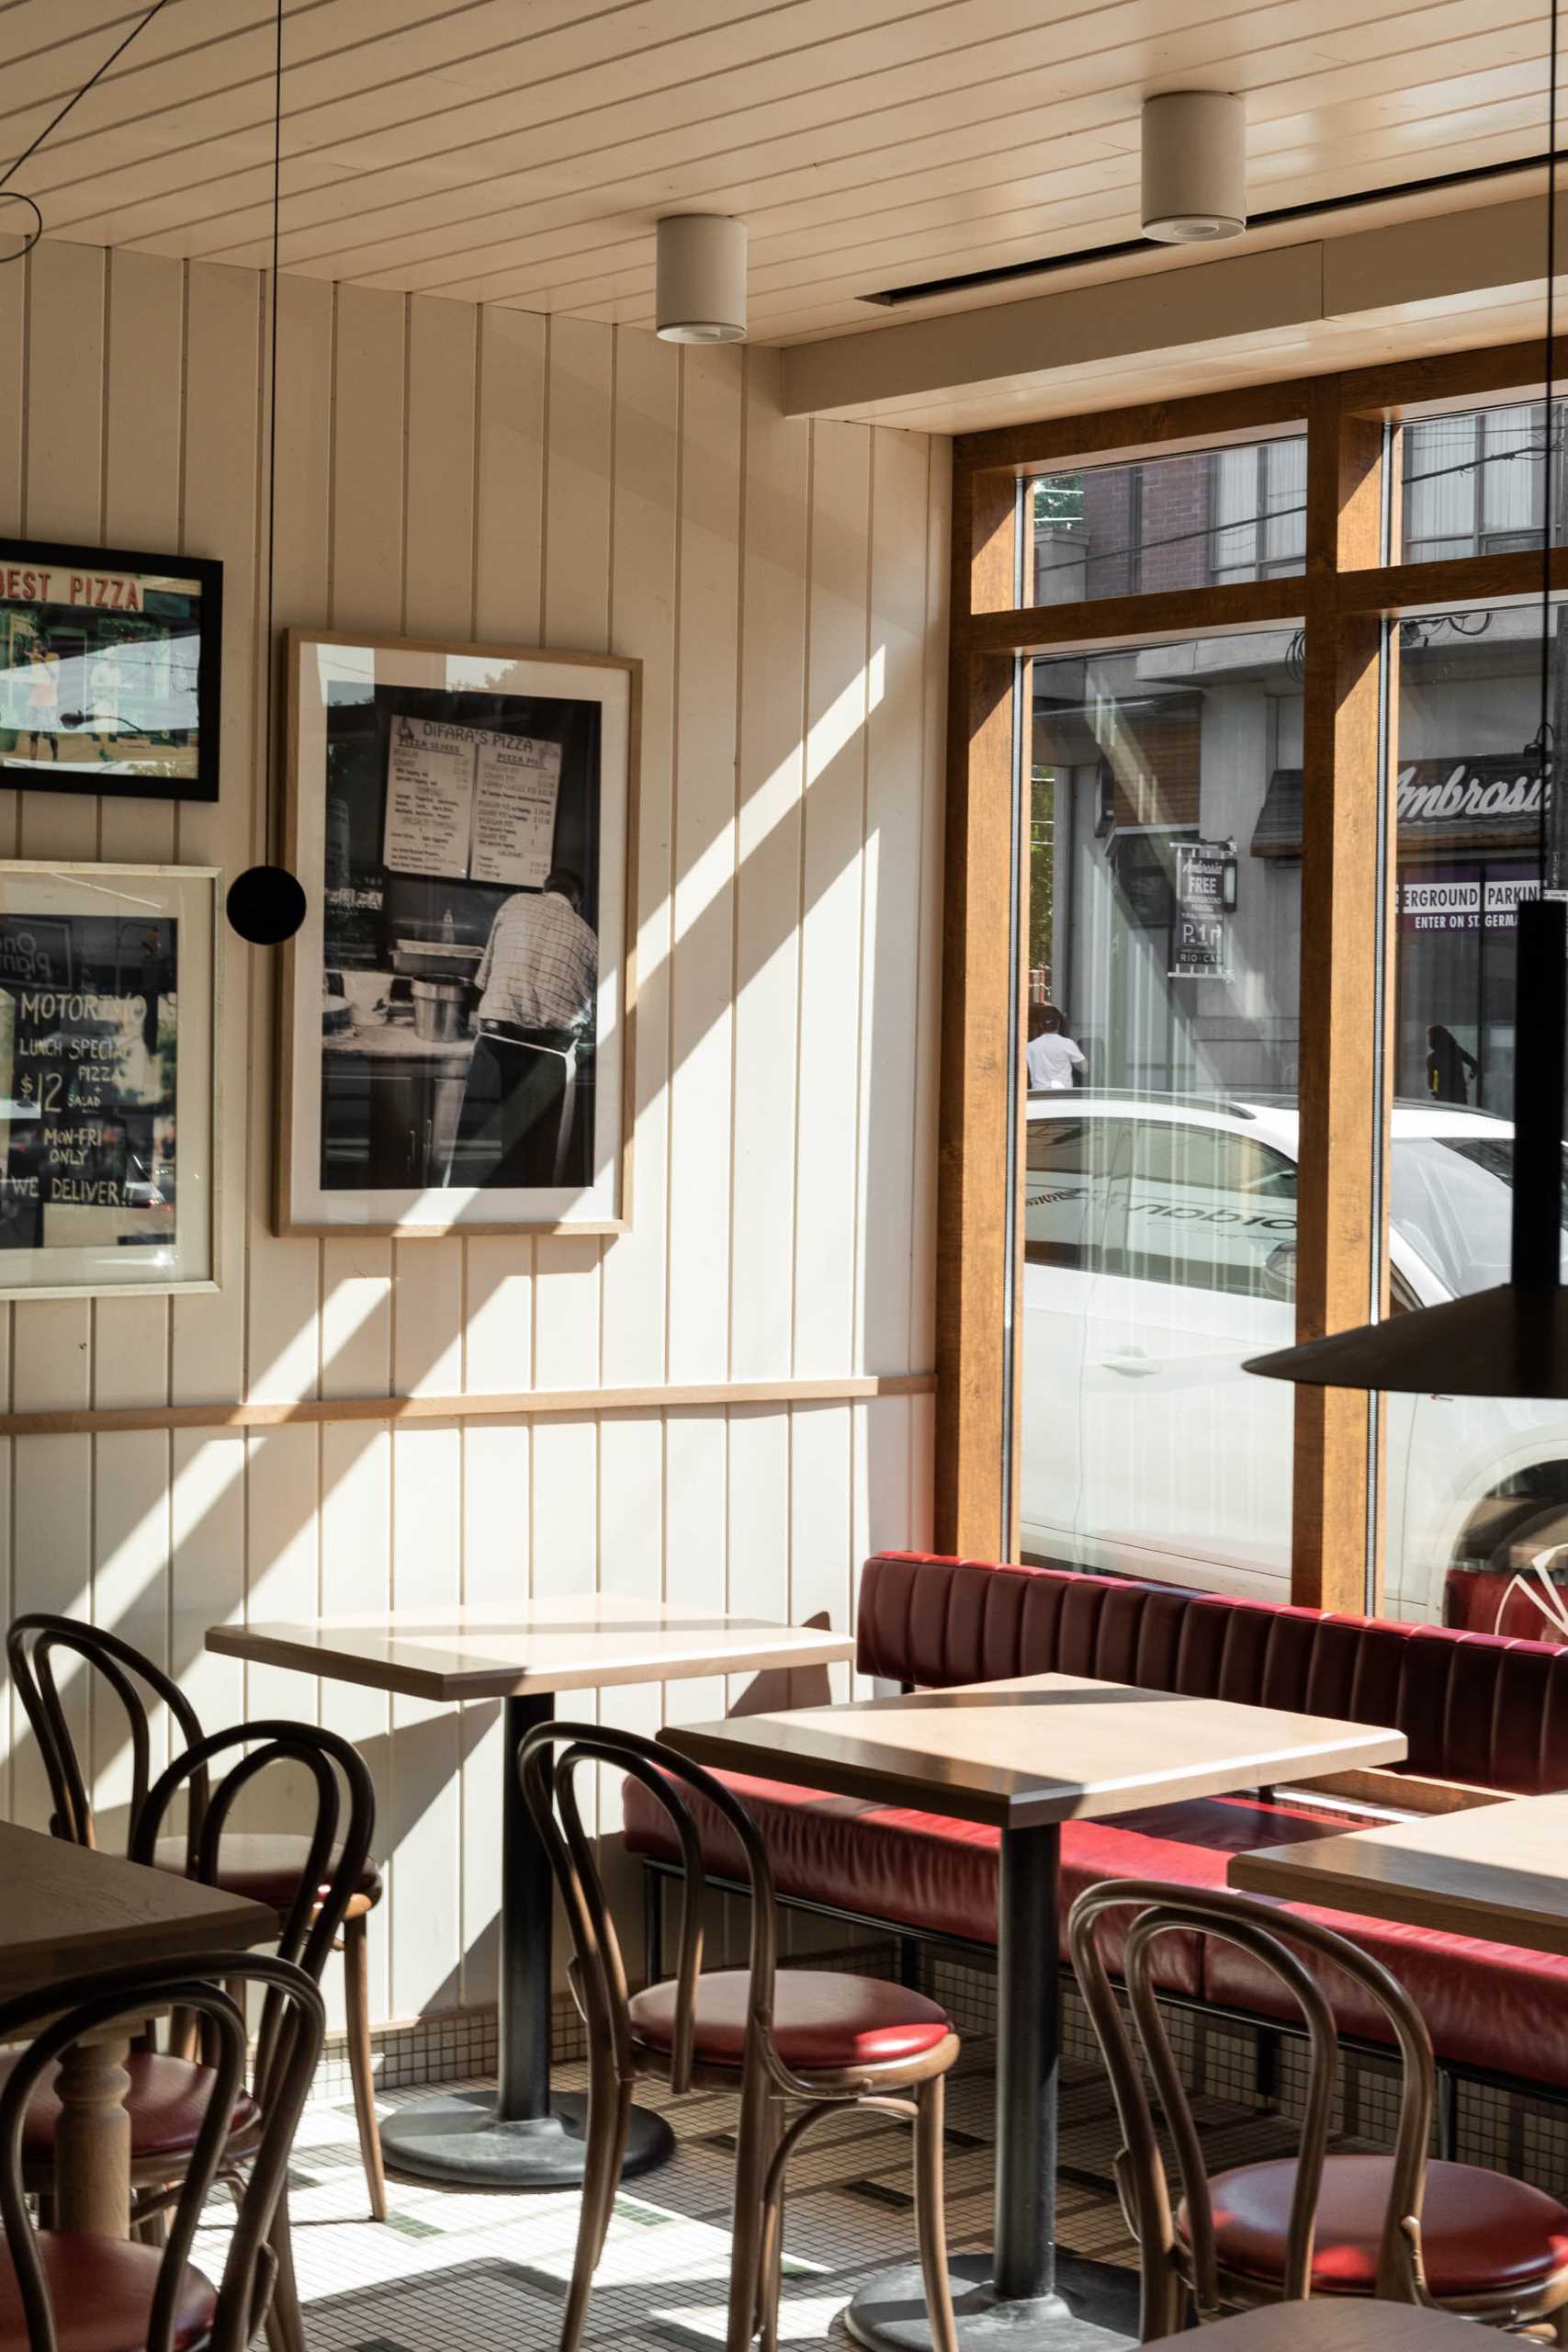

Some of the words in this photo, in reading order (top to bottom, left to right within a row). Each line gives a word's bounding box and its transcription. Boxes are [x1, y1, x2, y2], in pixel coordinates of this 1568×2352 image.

[69, 572, 141, 612] PIZZA
[491, 734, 533, 753] PIZZA
[1397, 764, 1551, 818] Ambrosi
[1189, 876, 1217, 894] FREE
[1396, 888, 1478, 908] ERGROUND
[1487, 886, 1541, 905] PARKIN
[1416, 916, 1446, 929] ENTER
[1450, 915, 1464, 927] ON
[19, 1037, 62, 1056] LUNCH
[78, 1066, 122, 1081] PIZZA
[50, 1149, 88, 1165] ONLY
[12, 1175, 39, 1197] WE
